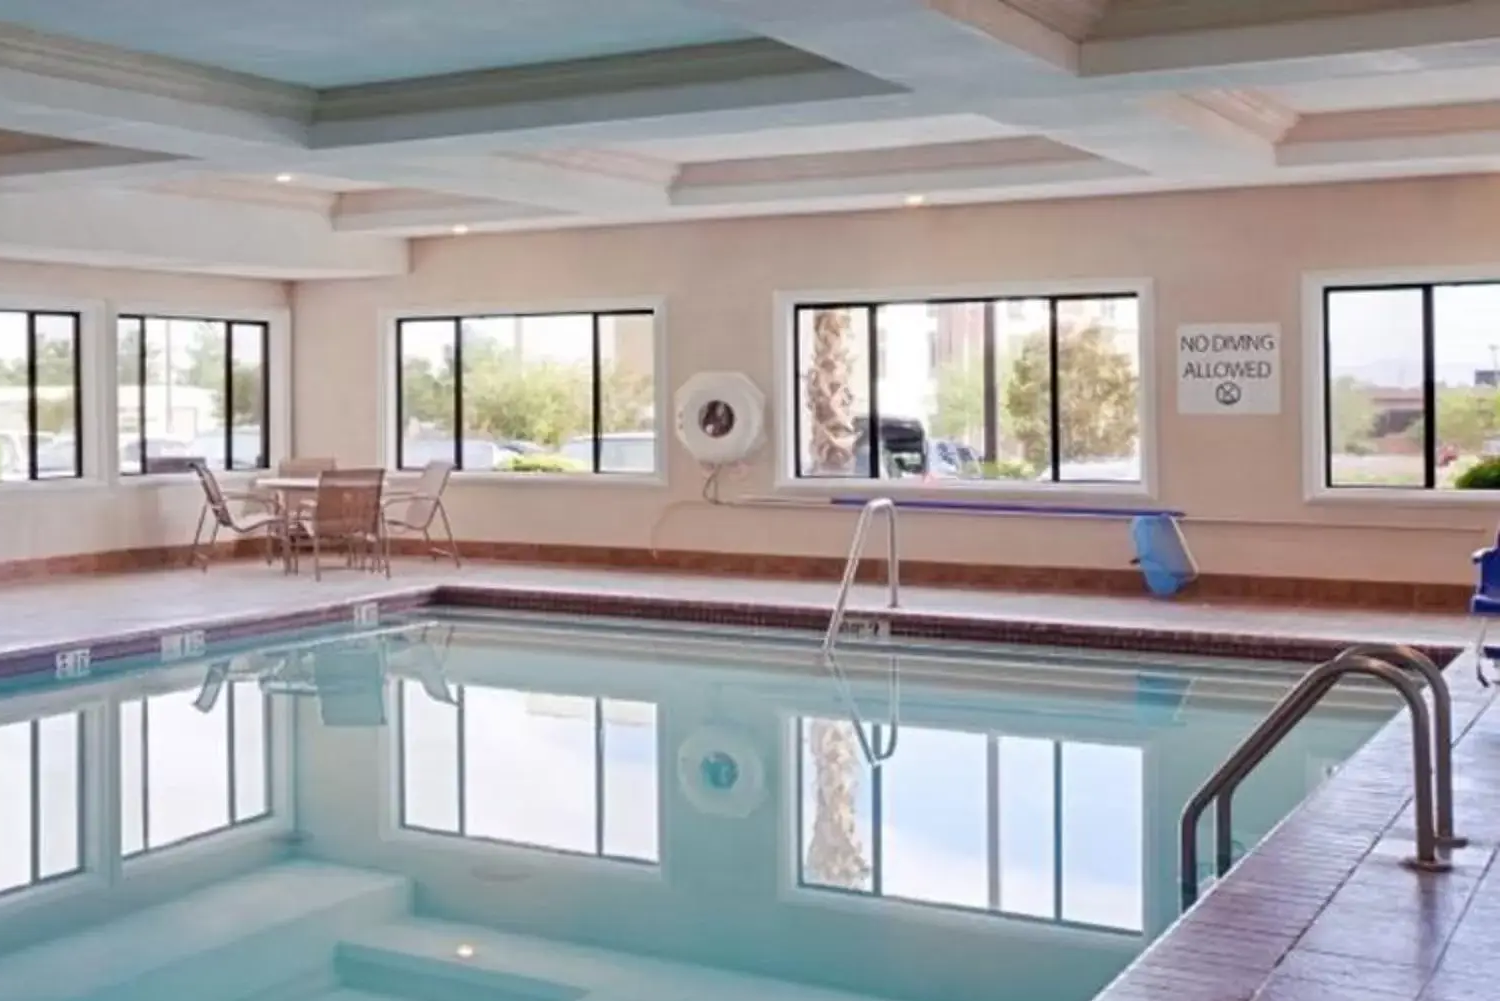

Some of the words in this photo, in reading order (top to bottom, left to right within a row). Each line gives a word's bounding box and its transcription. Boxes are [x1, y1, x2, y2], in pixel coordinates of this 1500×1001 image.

[1180, 334, 1210, 353] NO
[1211, 333, 1276, 352] DIVING
[1181, 360, 1272, 379] ALLOWED
